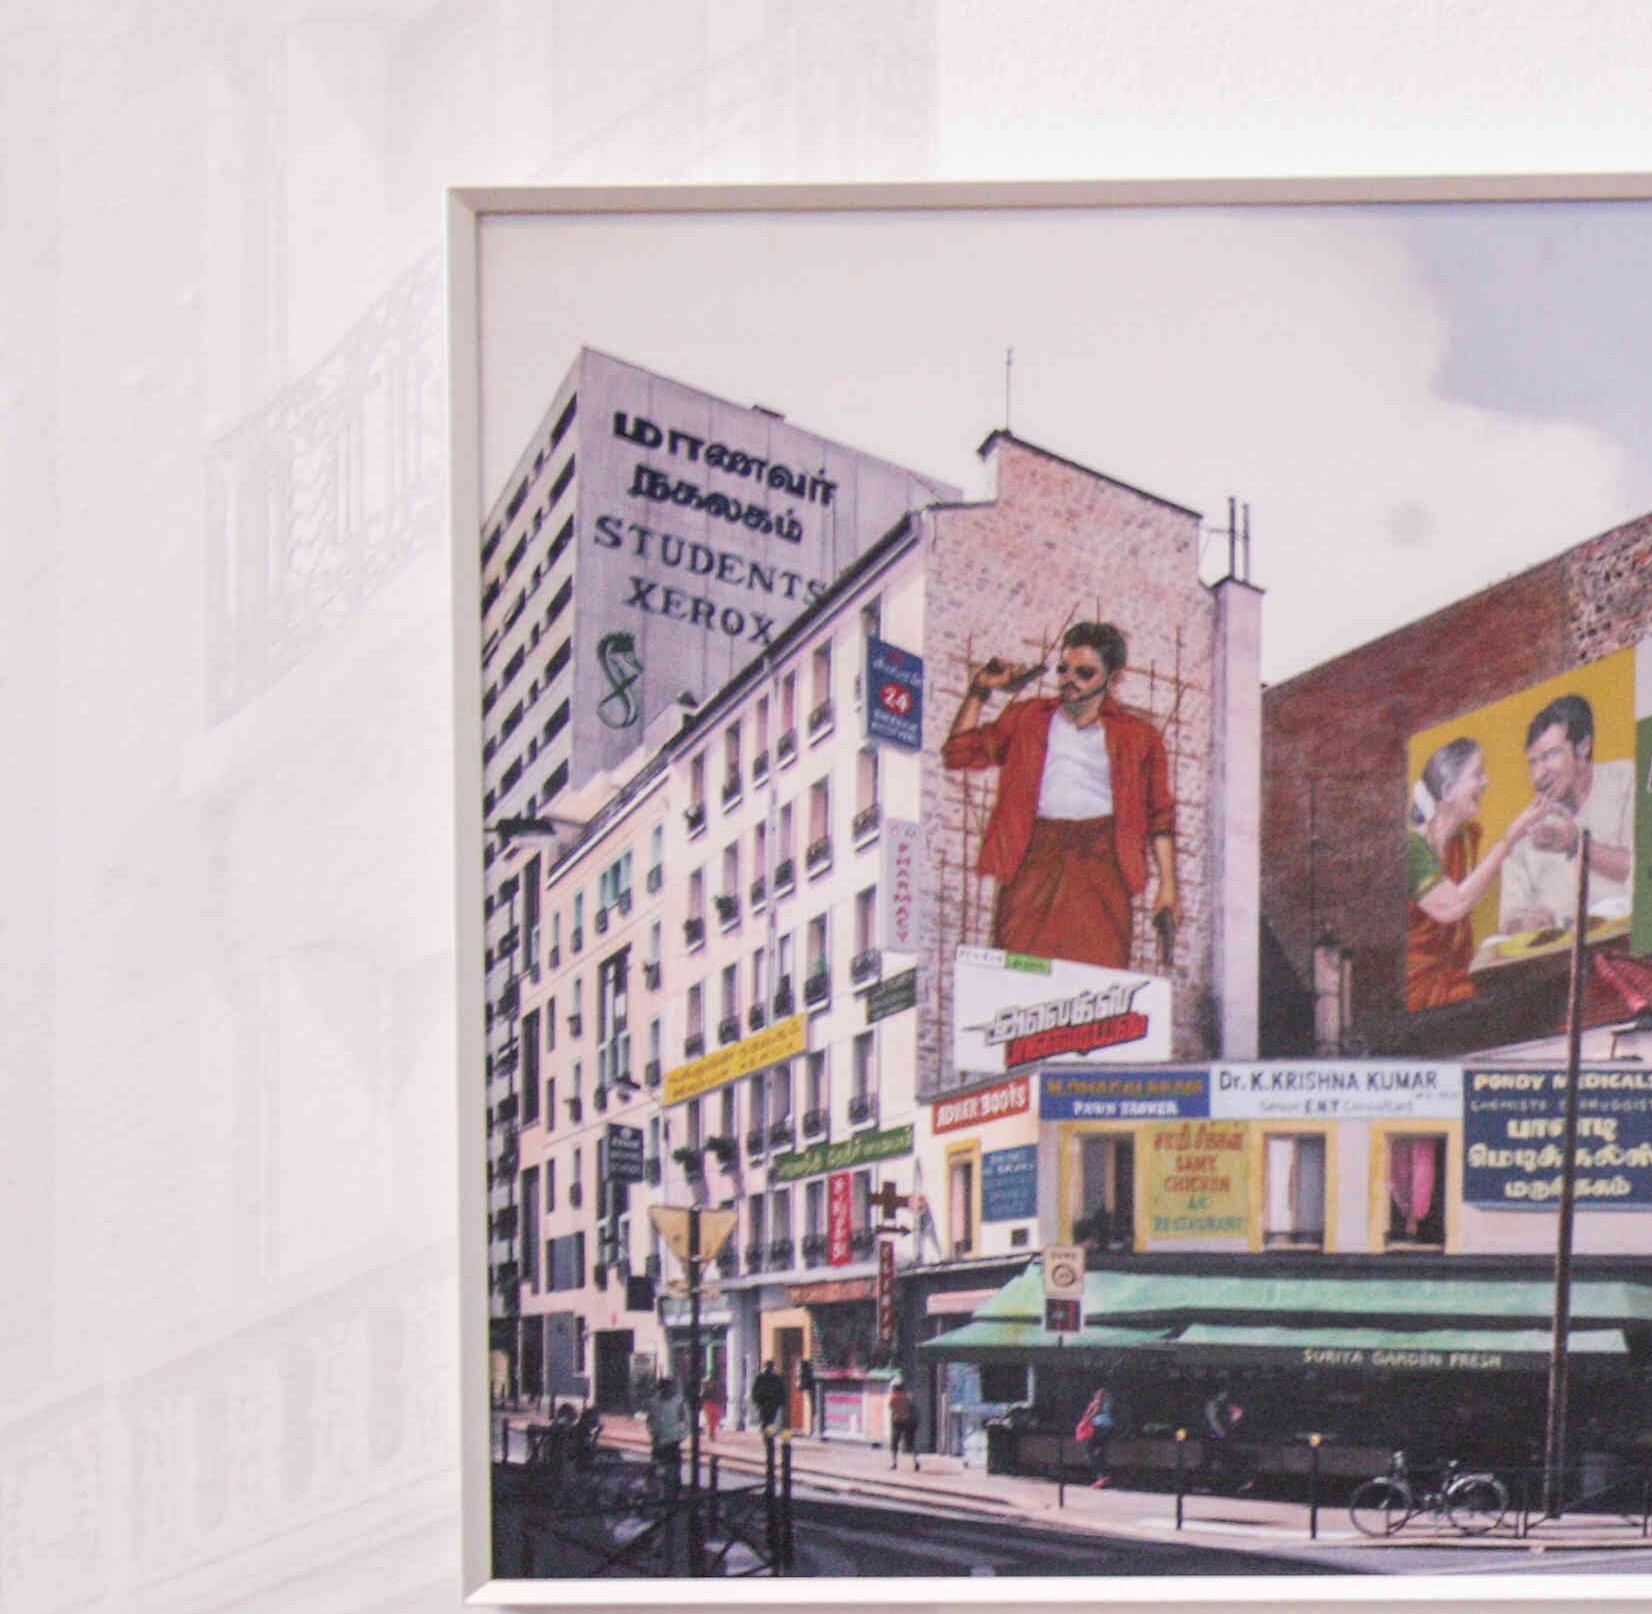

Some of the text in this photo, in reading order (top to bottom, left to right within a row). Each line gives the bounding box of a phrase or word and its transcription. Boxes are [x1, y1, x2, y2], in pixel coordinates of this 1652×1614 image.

[594, 514, 829, 604] STUDENTS
[623, 575, 776, 647] XEROX
[1218, 1070, 1248, 1092] Dr.
[1367, 1070, 1438, 1092] KUMAR
[1448, 1351, 1502, 1368] FRESH
